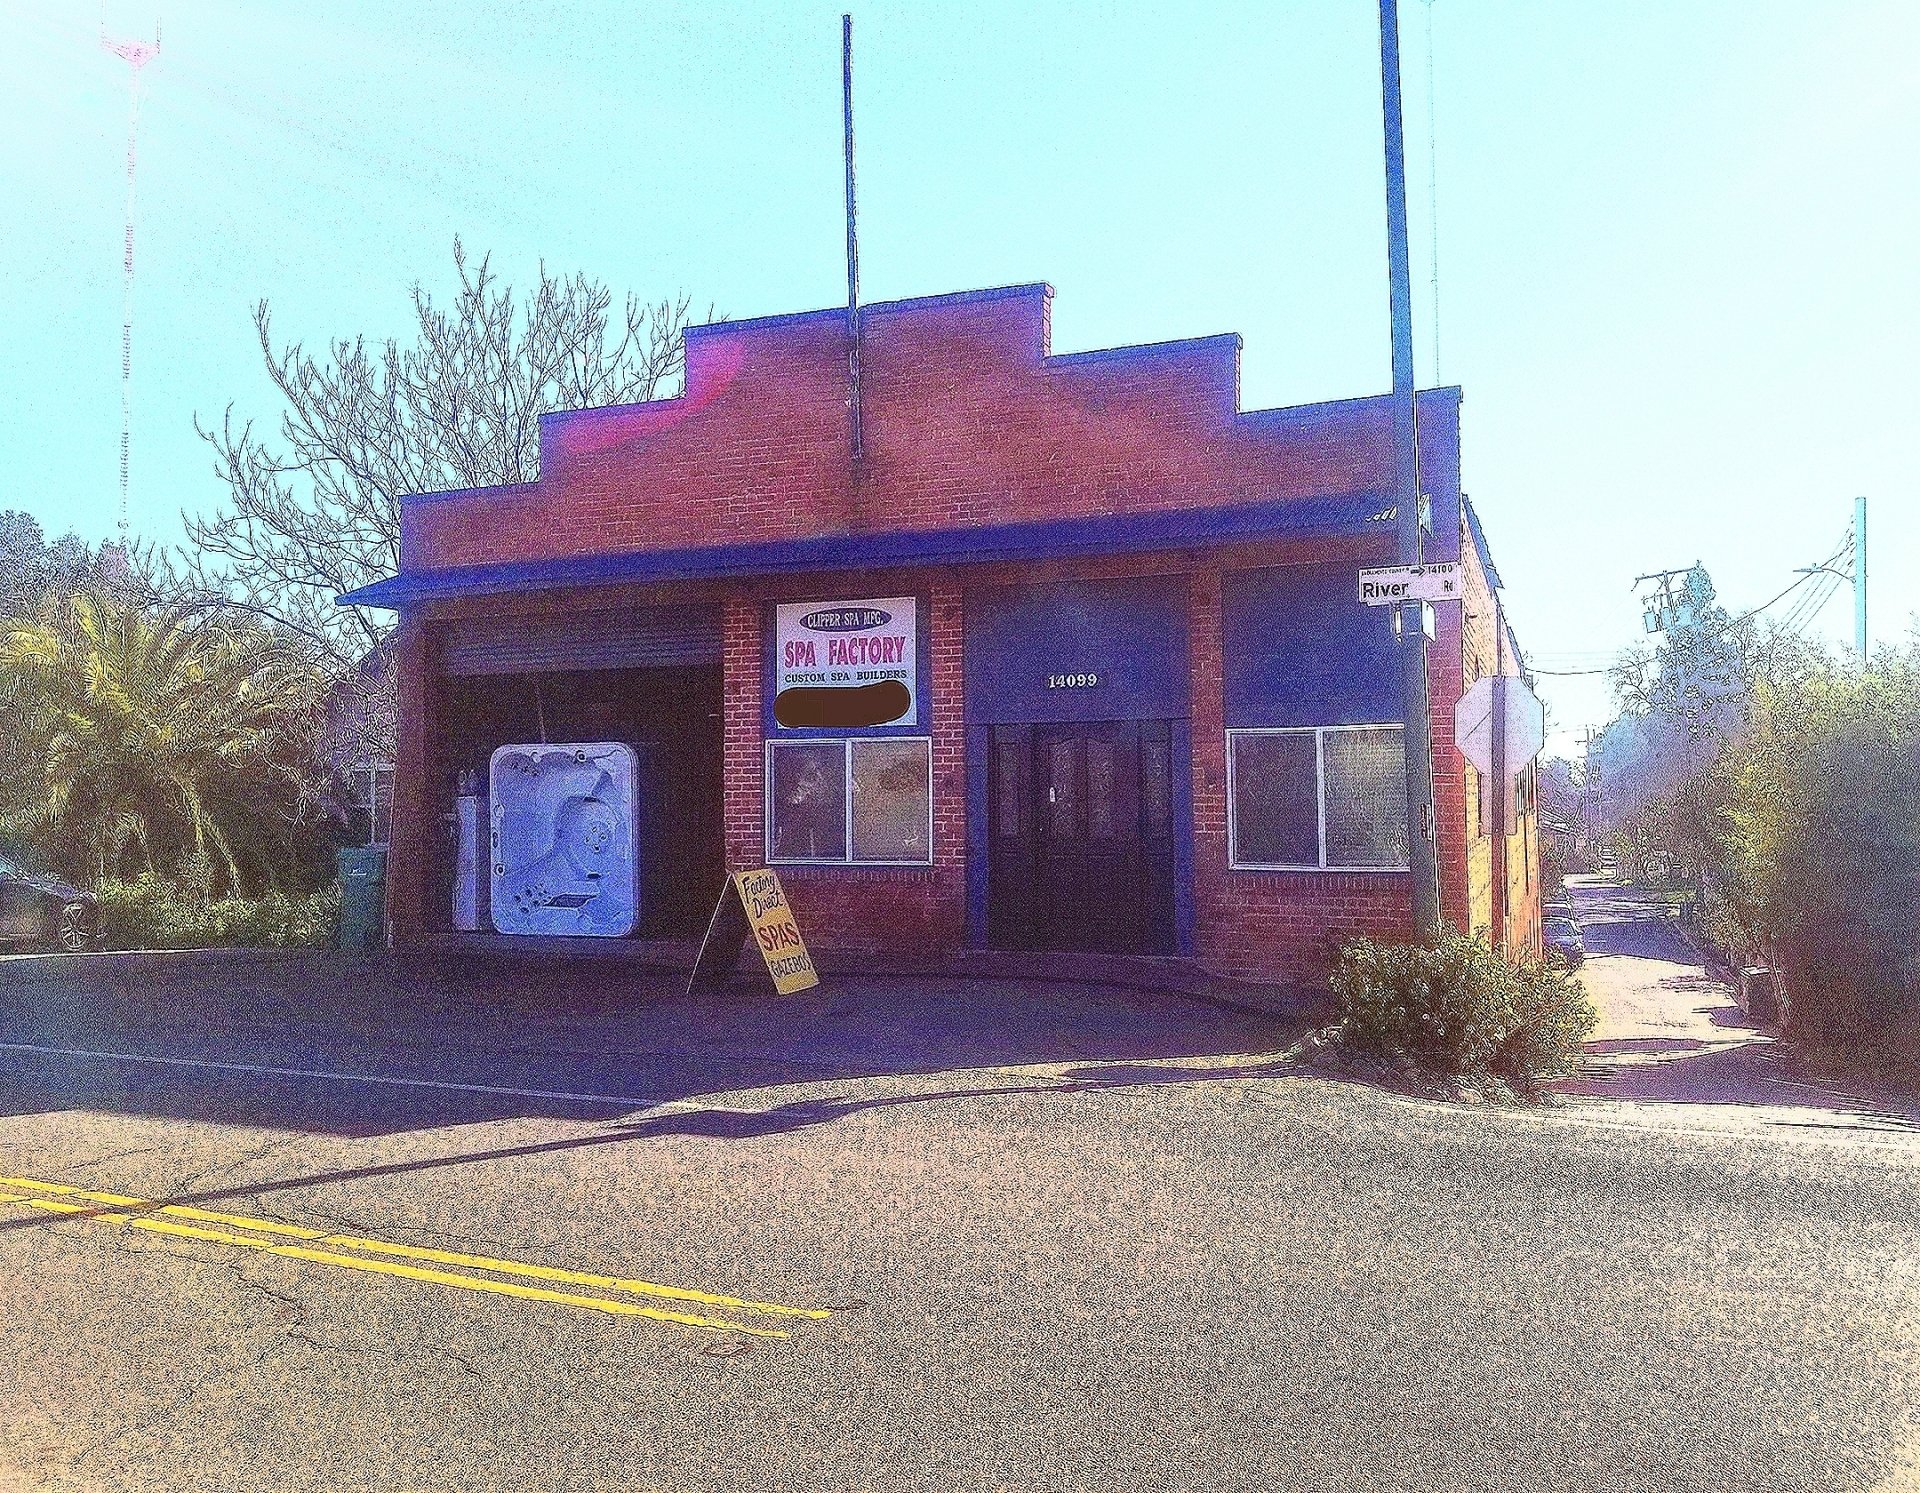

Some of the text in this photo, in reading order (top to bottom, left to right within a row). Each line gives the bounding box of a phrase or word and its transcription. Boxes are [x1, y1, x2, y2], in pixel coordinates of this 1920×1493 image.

[1428, 564, 1453, 575] 14100
[1362, 580, 1454, 598] River Rd
[807, 610, 884, 628] CLIPPER SPA MFG.
[784, 636, 906, 668] SPA FACTORY
[785, 669, 907, 683] CUSTOM SPA BUILDERS
[1048, 673, 1098, 688] 14099
[758, 922, 800, 951] SPAS
